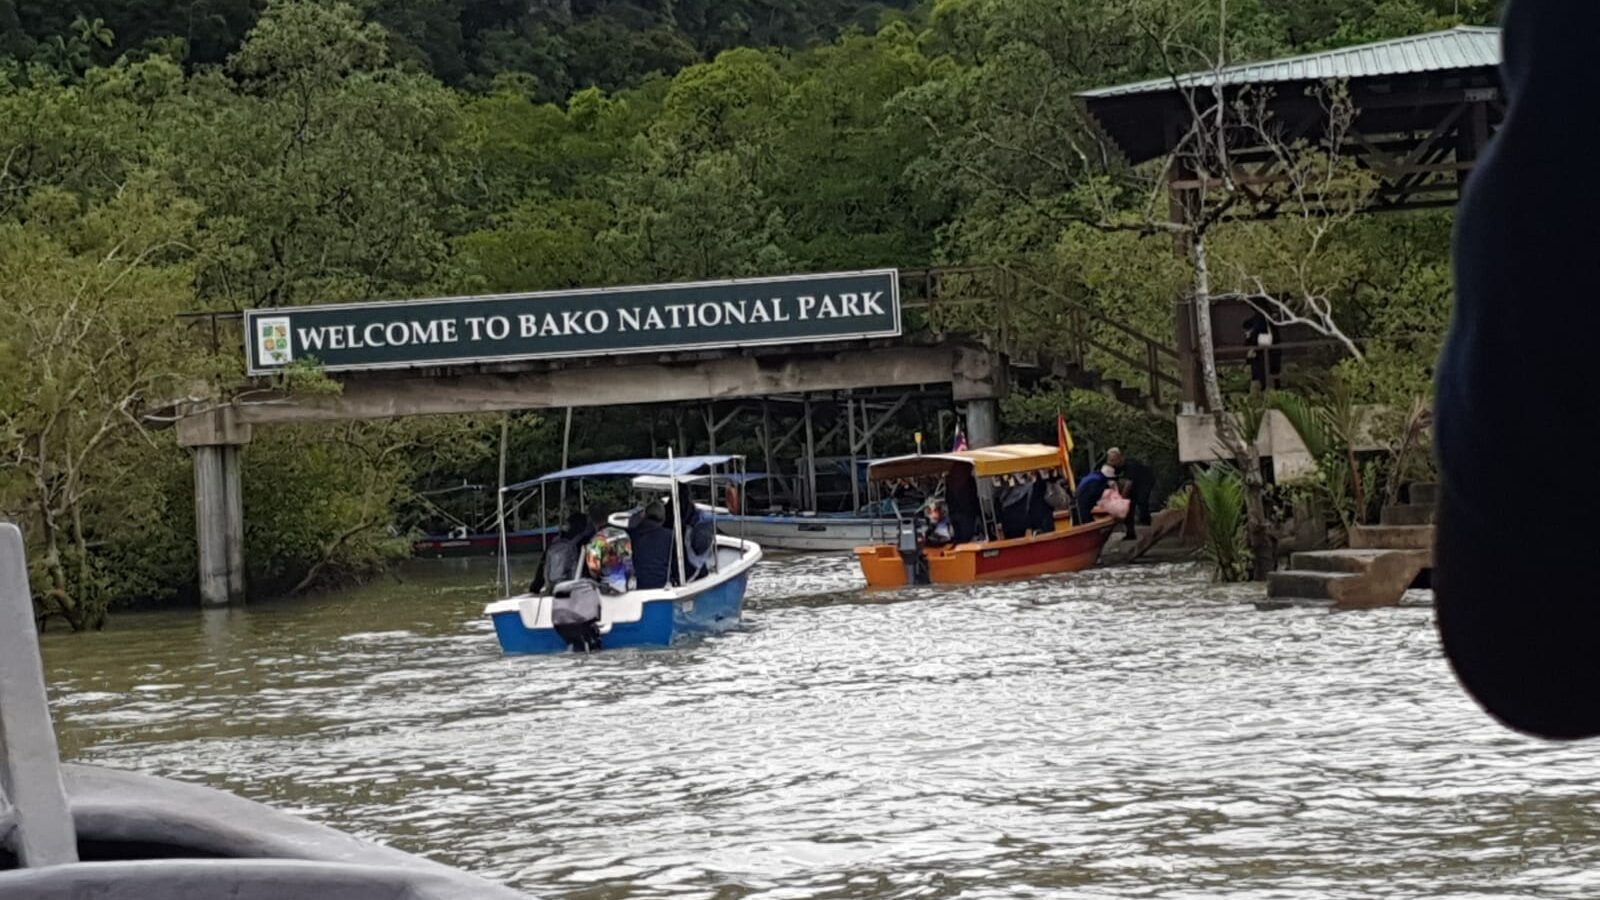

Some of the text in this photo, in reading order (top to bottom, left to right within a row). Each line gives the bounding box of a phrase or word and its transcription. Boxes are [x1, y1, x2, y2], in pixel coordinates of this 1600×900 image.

[297, 291, 885, 351] WELCOME TO BAKO NATIONAL PARK
